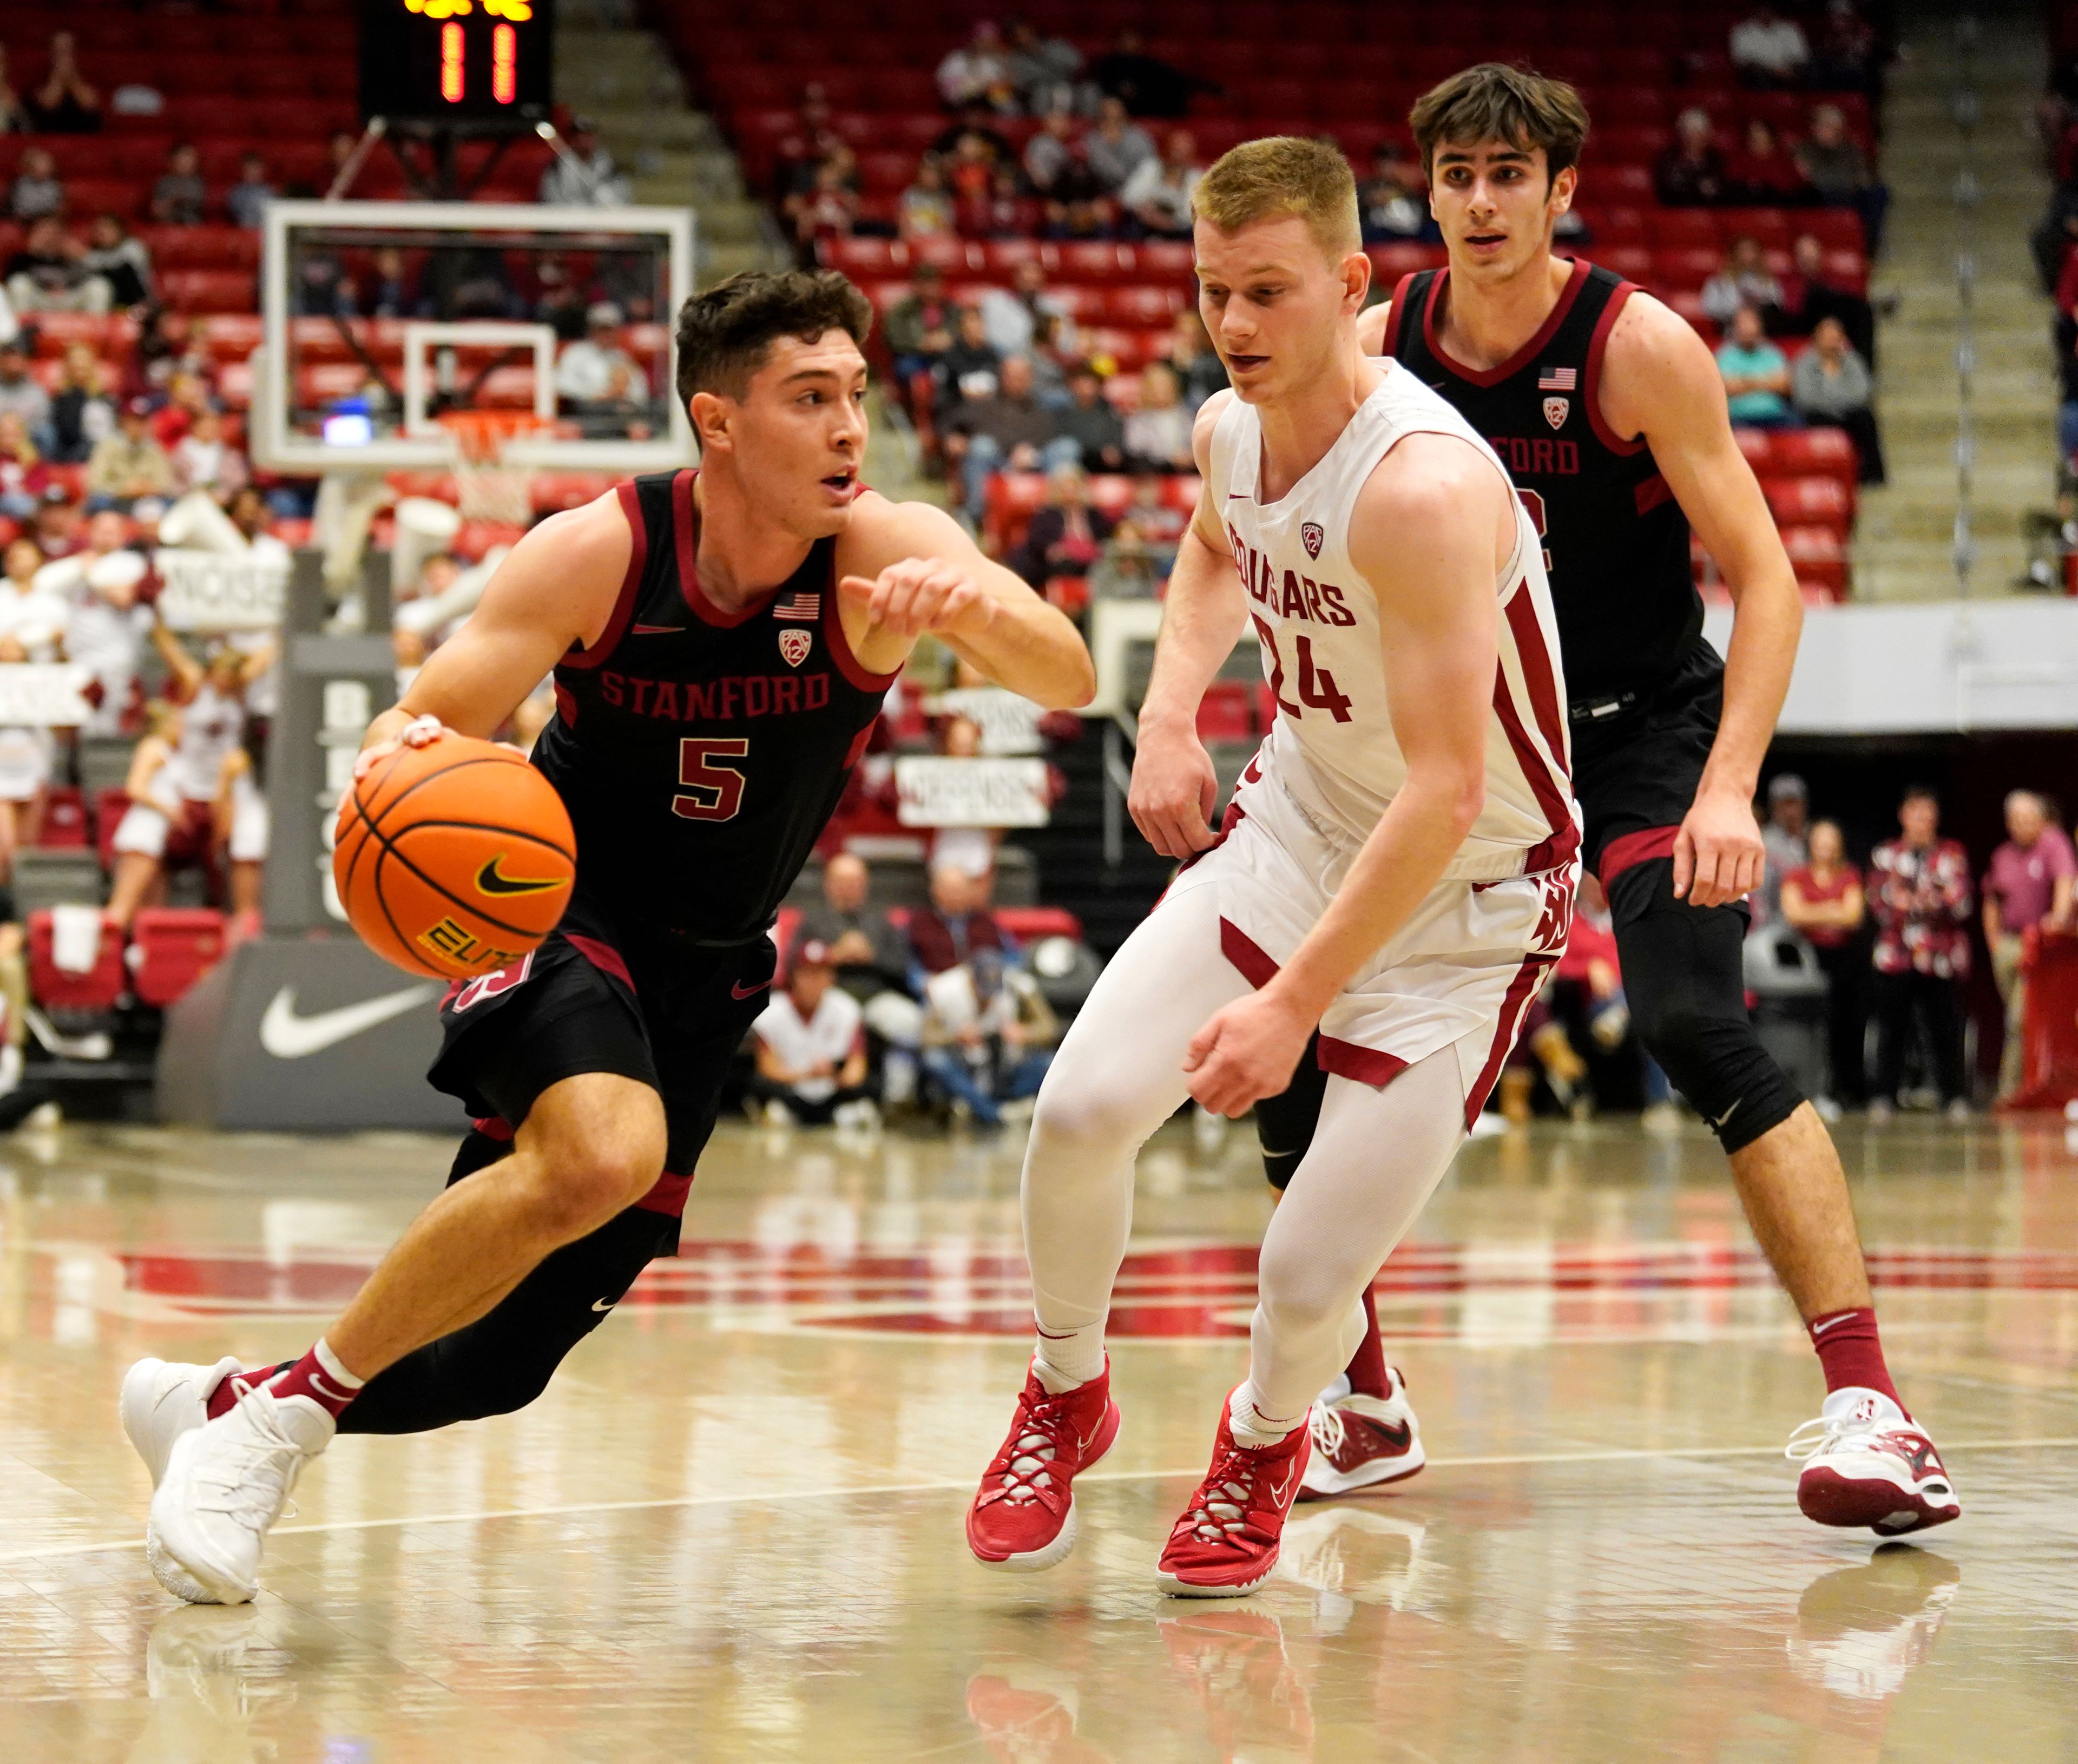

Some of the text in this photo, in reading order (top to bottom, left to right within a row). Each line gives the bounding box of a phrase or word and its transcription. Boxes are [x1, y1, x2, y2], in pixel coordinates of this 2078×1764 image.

[1303, 525, 1323, 547] PAC
[1307, 539, 1317, 552] 12
[782, 632, 810, 653] PAC
[787, 646, 804, 659] 12
[1250, 609, 1353, 723] 24
[601, 670, 830, 721] STANFORD
[671, 738, 749, 823] 5
